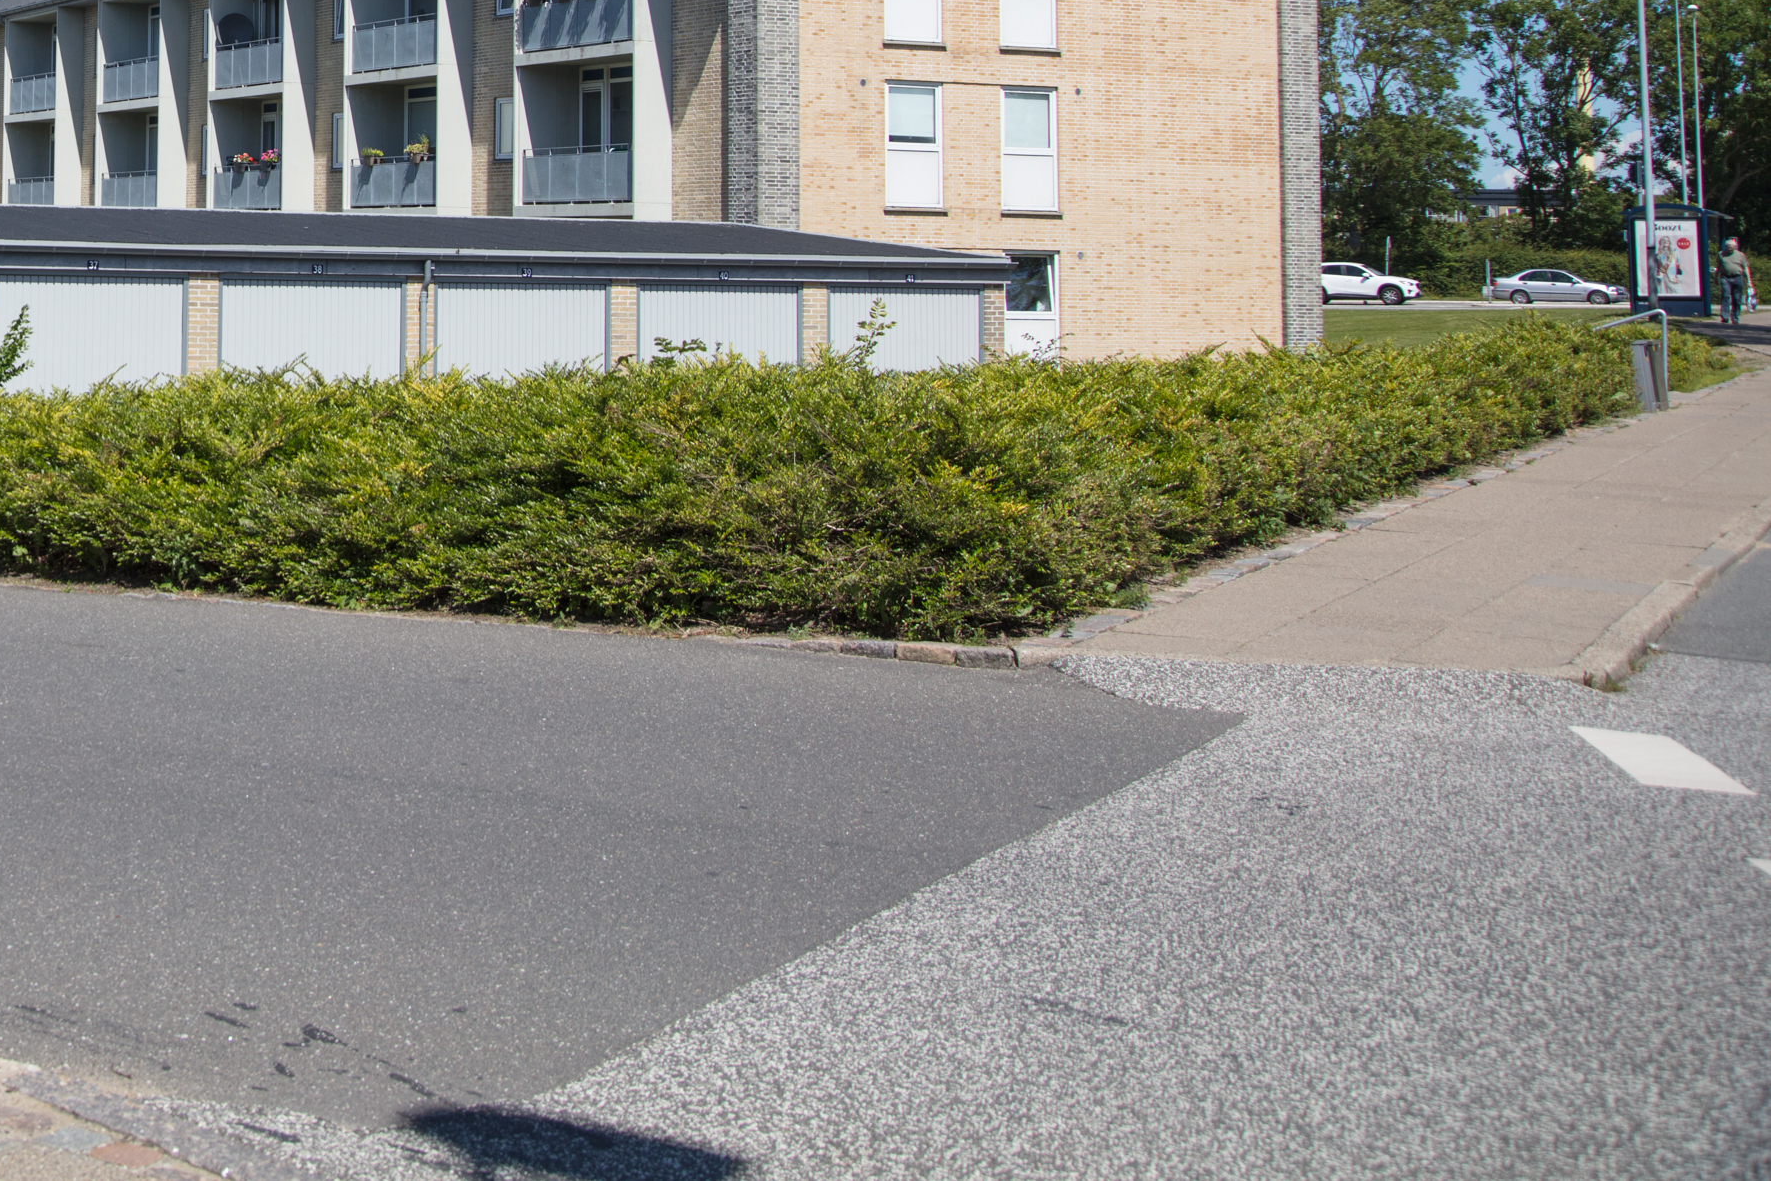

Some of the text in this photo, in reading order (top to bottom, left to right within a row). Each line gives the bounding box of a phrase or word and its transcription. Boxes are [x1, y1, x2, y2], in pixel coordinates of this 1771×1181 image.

[88, 260, 98, 270] 37
[313, 264, 323, 274] 38
[522, 268, 532, 277] 39
[719, 271, 729, 280] 40
[906, 274, 915, 283] 41
